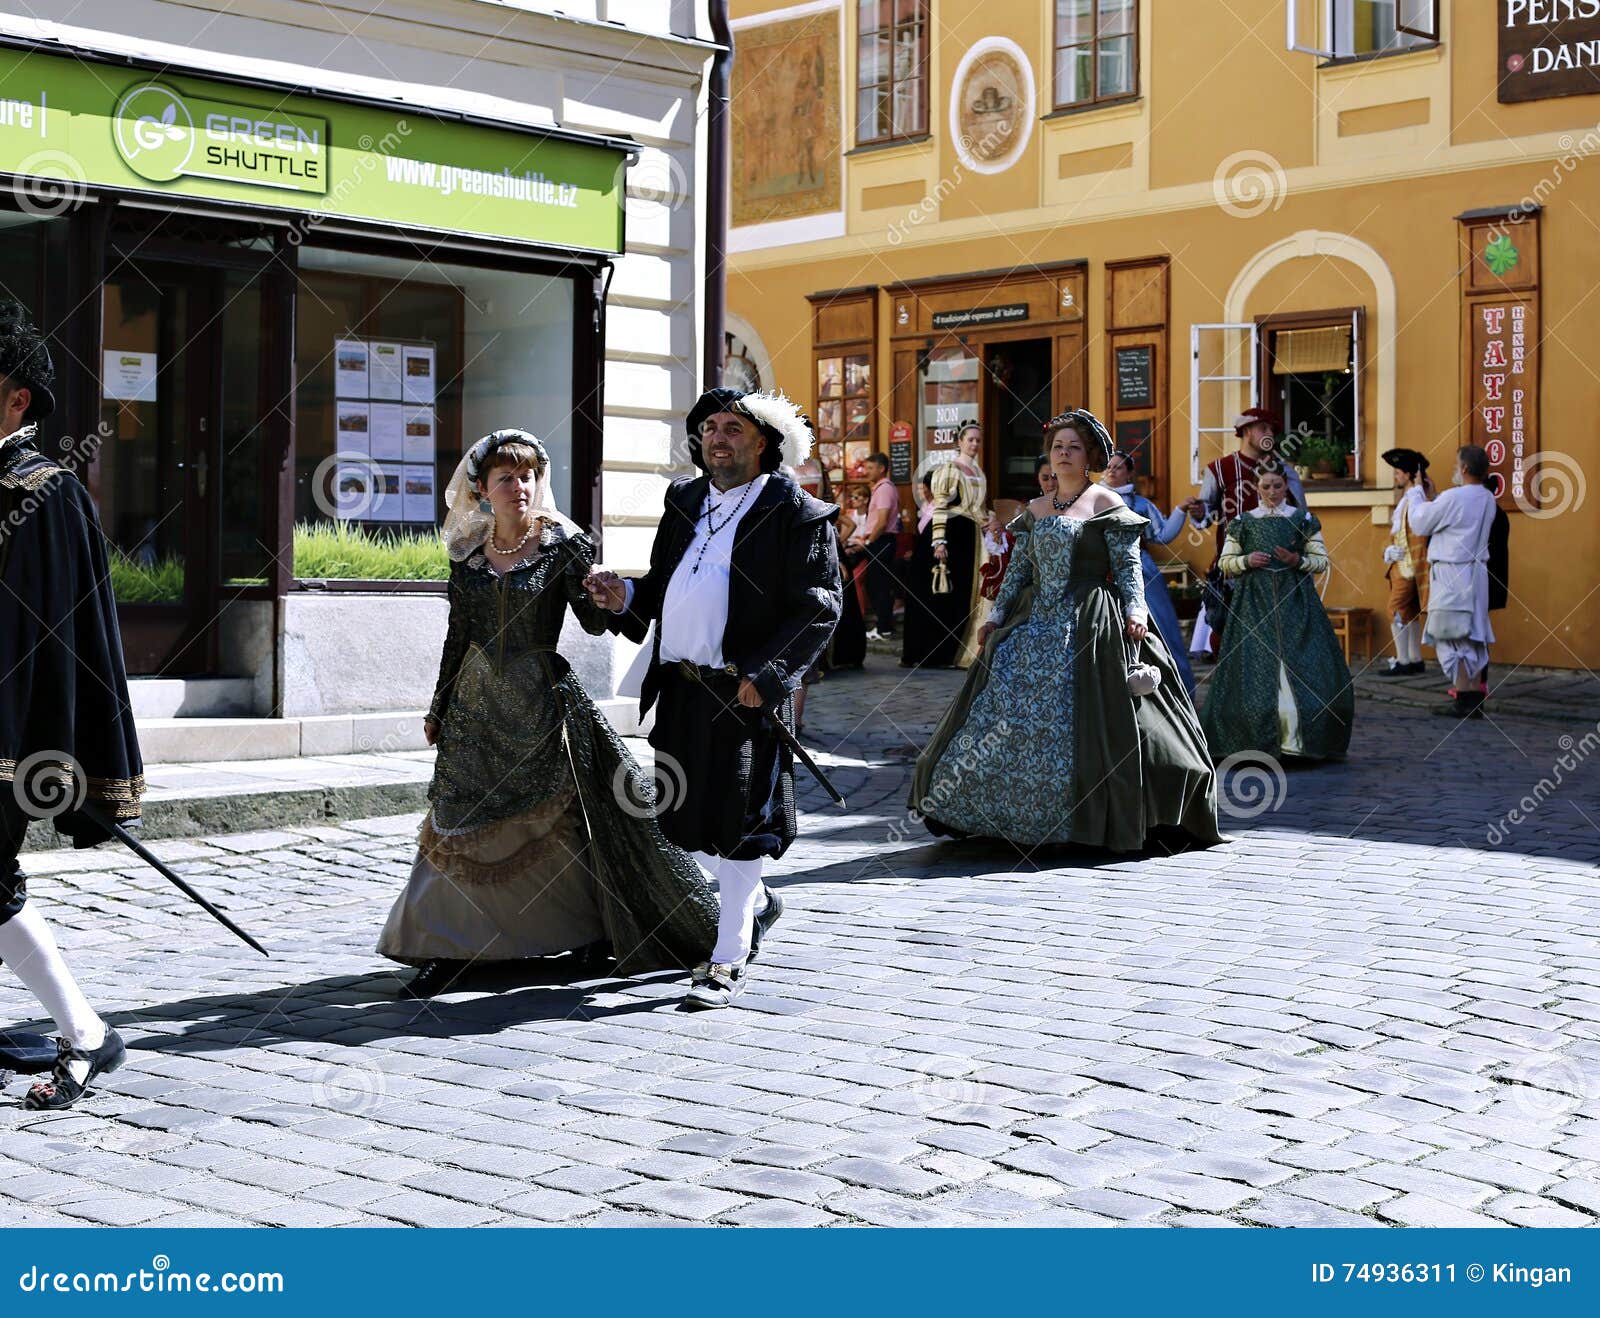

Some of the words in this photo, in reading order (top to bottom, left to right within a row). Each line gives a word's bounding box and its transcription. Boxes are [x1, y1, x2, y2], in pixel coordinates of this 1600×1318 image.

[1505, 0, 1600, 27] PENS
[1532, 40, 1600, 74] DAN
[206, 113, 319, 155] GREEN
[207, 146, 318, 179] SHUTTLE
[386, 155, 579, 208] www.greenshuttle.cz
[1511, 306, 1525, 374] HENNA
[936, 407, 959, 423] NON
[934, 428, 956, 444] SOL
[1511, 389, 1524, 498] PIERCING
